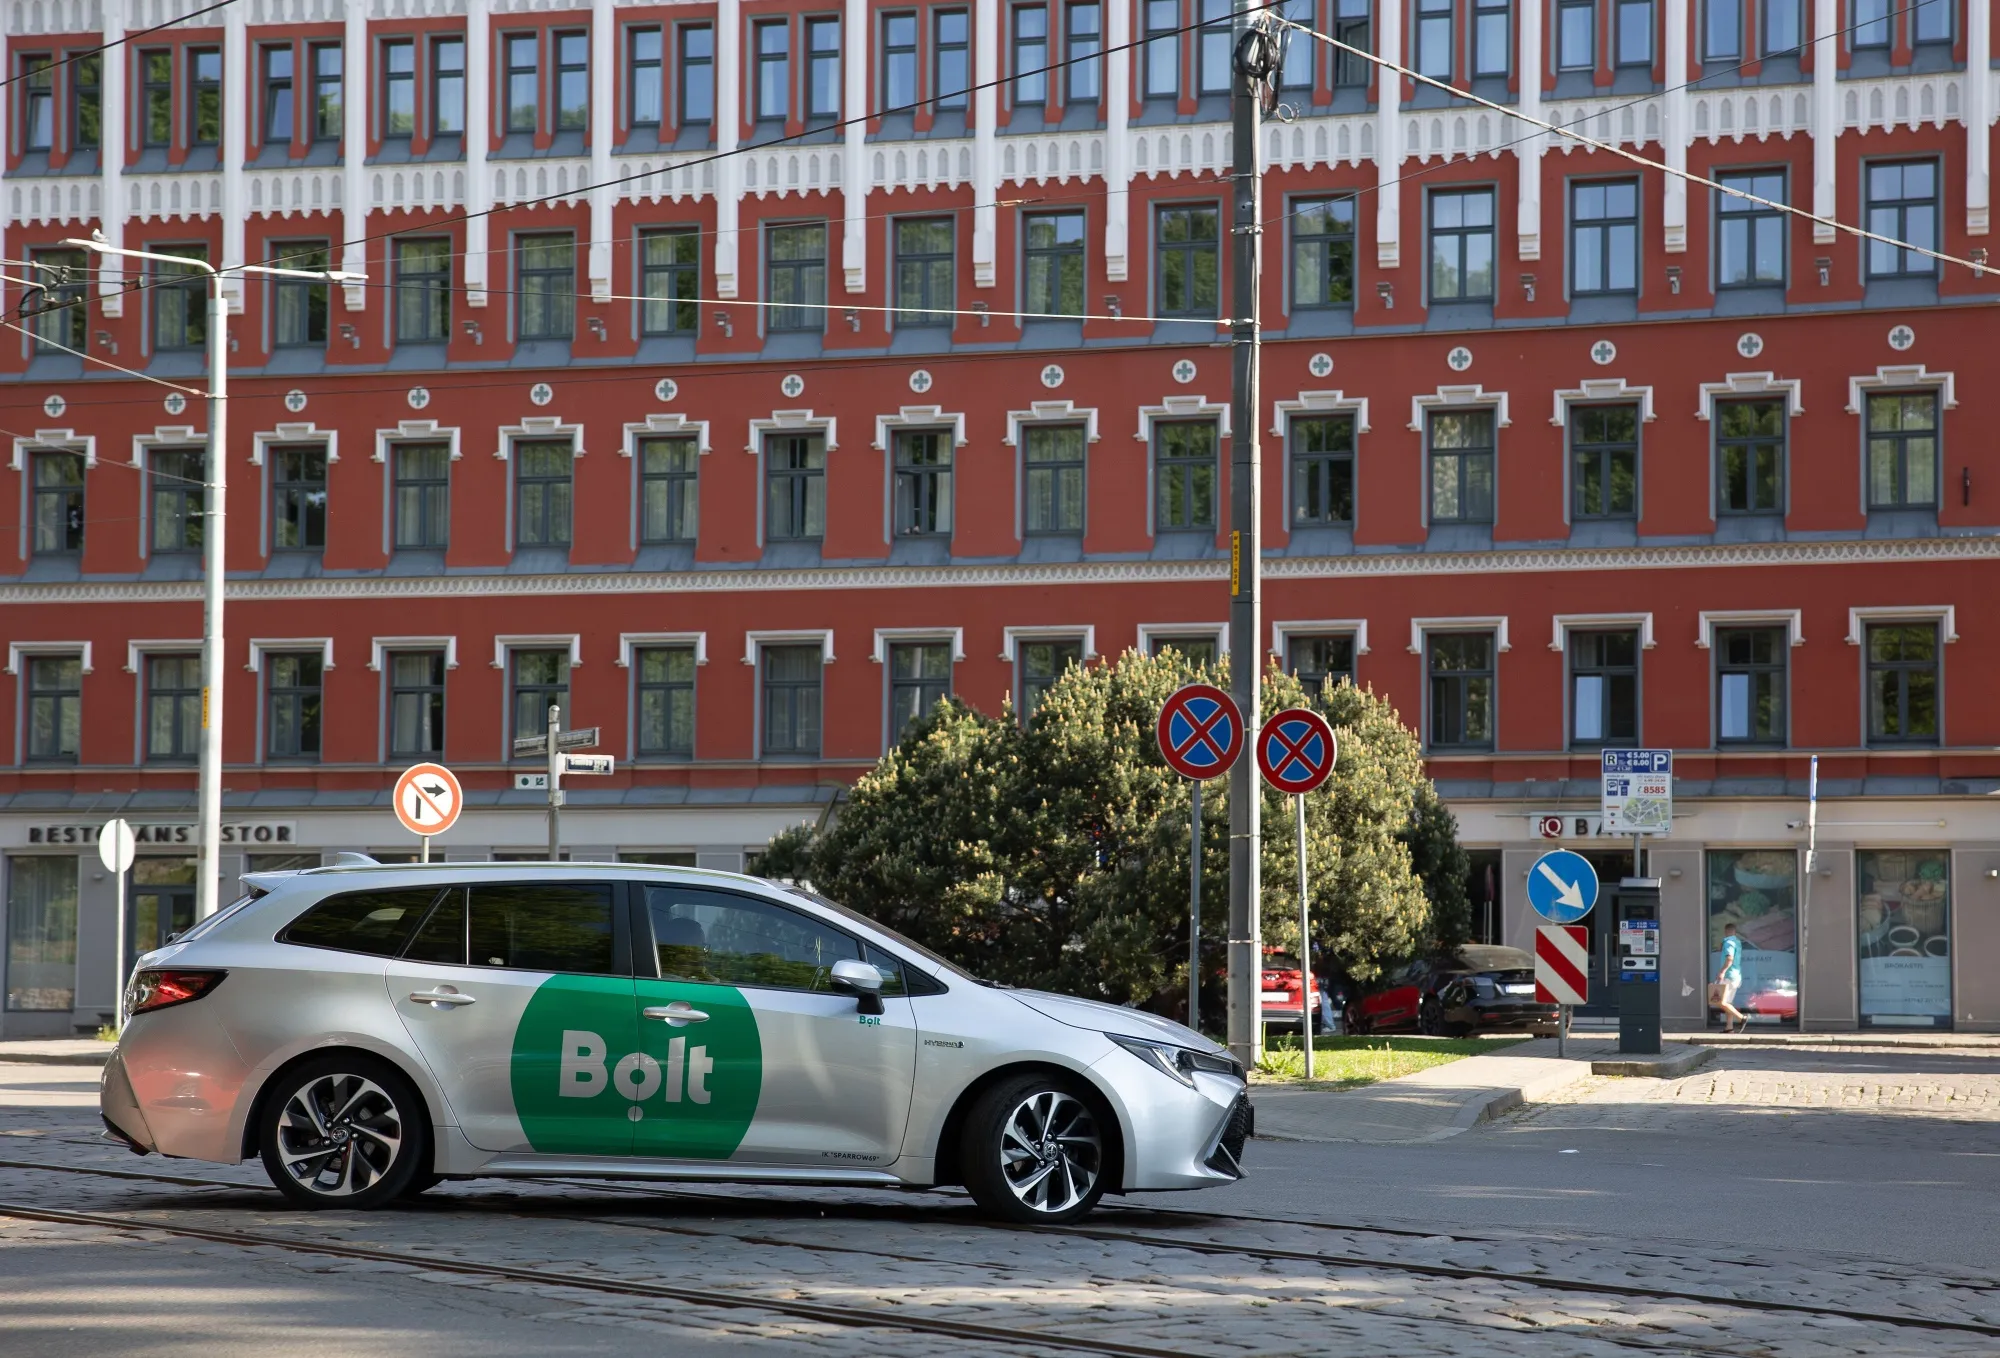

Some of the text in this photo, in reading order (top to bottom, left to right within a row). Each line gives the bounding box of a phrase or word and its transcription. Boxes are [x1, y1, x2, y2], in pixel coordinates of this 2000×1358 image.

[1607, 755, 1616, 764] R
[1654, 754, 1667, 771] P
[1643, 785, 1666, 794] 8585
[220, 825, 290, 842] STOR
[1541, 818, 1562, 836] iQ
[859, 1015, 881, 1027] Bolt
[558, 1029, 714, 1122] Bolt
